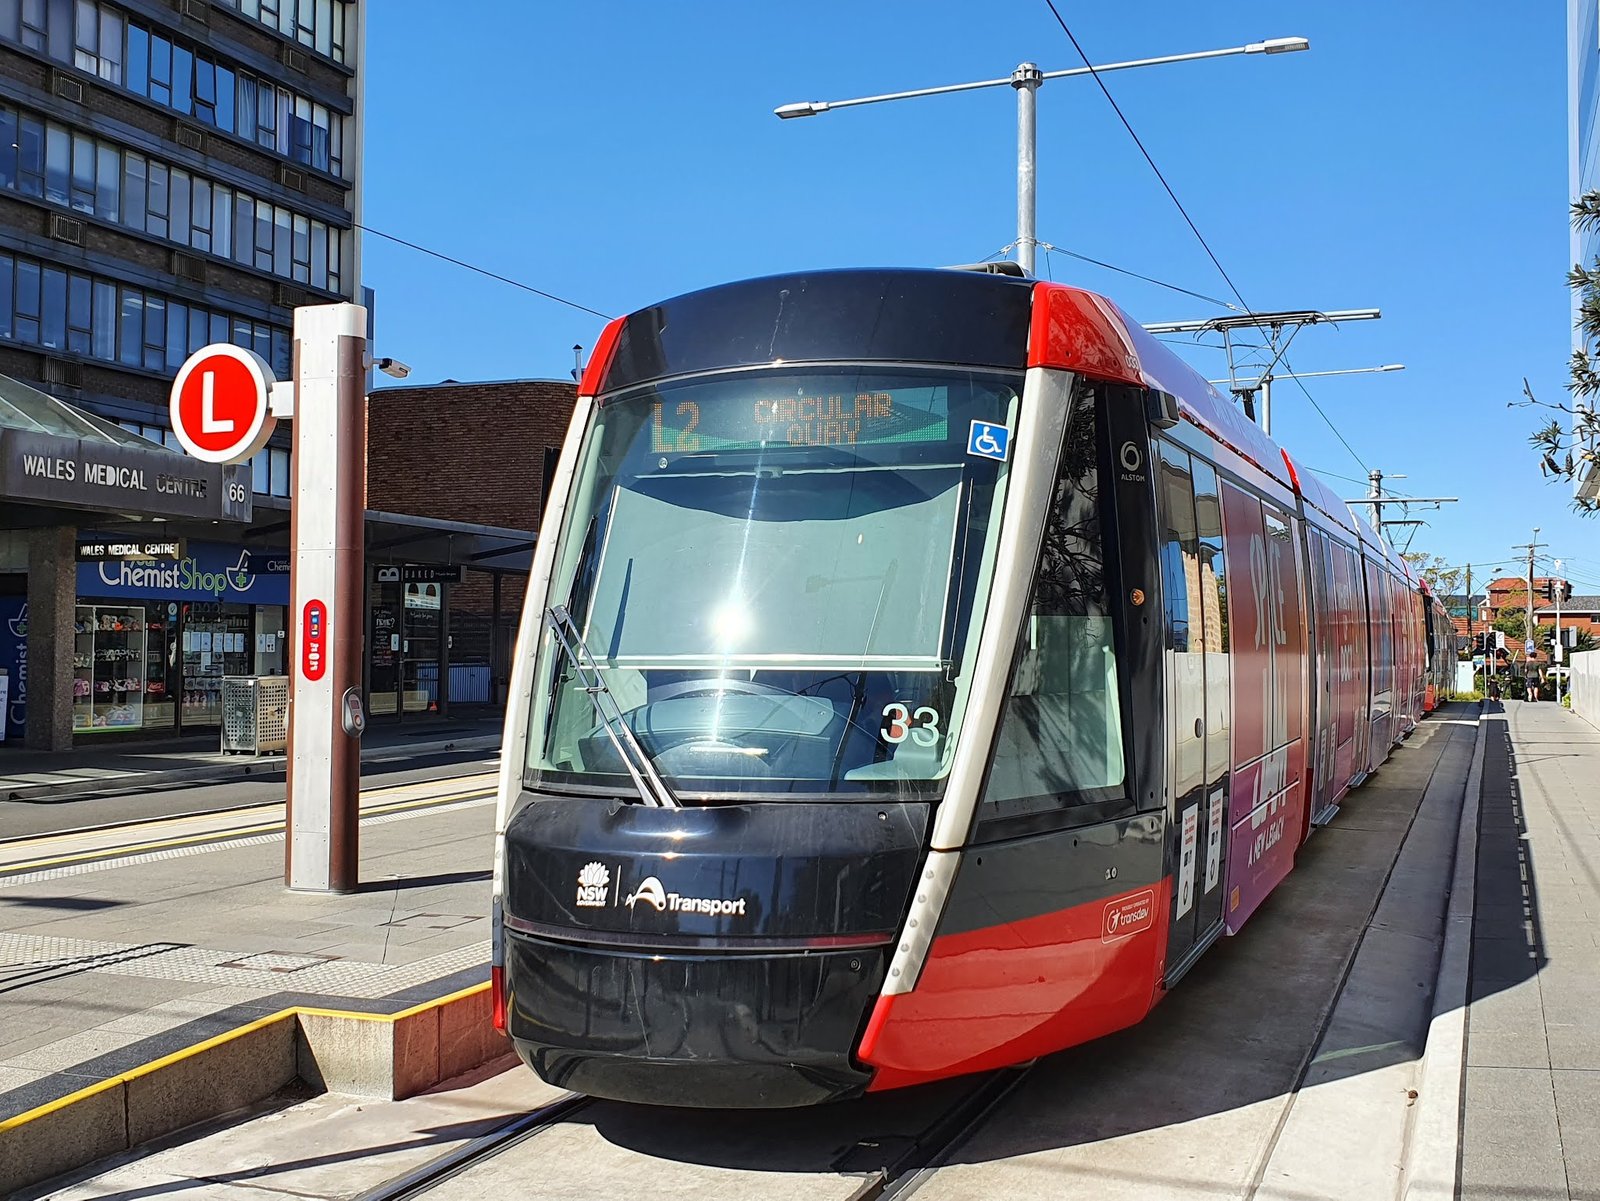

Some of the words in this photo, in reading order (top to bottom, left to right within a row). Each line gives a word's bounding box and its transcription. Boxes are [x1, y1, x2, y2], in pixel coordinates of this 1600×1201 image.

[202, 371, 234, 434] L
[653, 401, 699, 452] L2
[754, 393, 892, 424] CIRCULAR
[786, 420, 861, 447] QUAY
[24, 454, 76, 481] WALES
[84, 462, 148, 491] MEDICAL
[156, 473, 208, 499] CENTRE
[1120, 473, 1145, 482] ALSTOM
[229, 483, 245, 503] 66
[80, 545, 105, 556] WALES
[108, 544, 141, 556] MEDICAL
[145, 543, 175, 555] CENTRE
[405, 569, 435, 579] BAKED
[880, 703, 940, 748] 33
[576, 886, 609, 901] NSW
[667, 893, 746, 917] Transport
[1120, 907, 1149, 926] transdev
